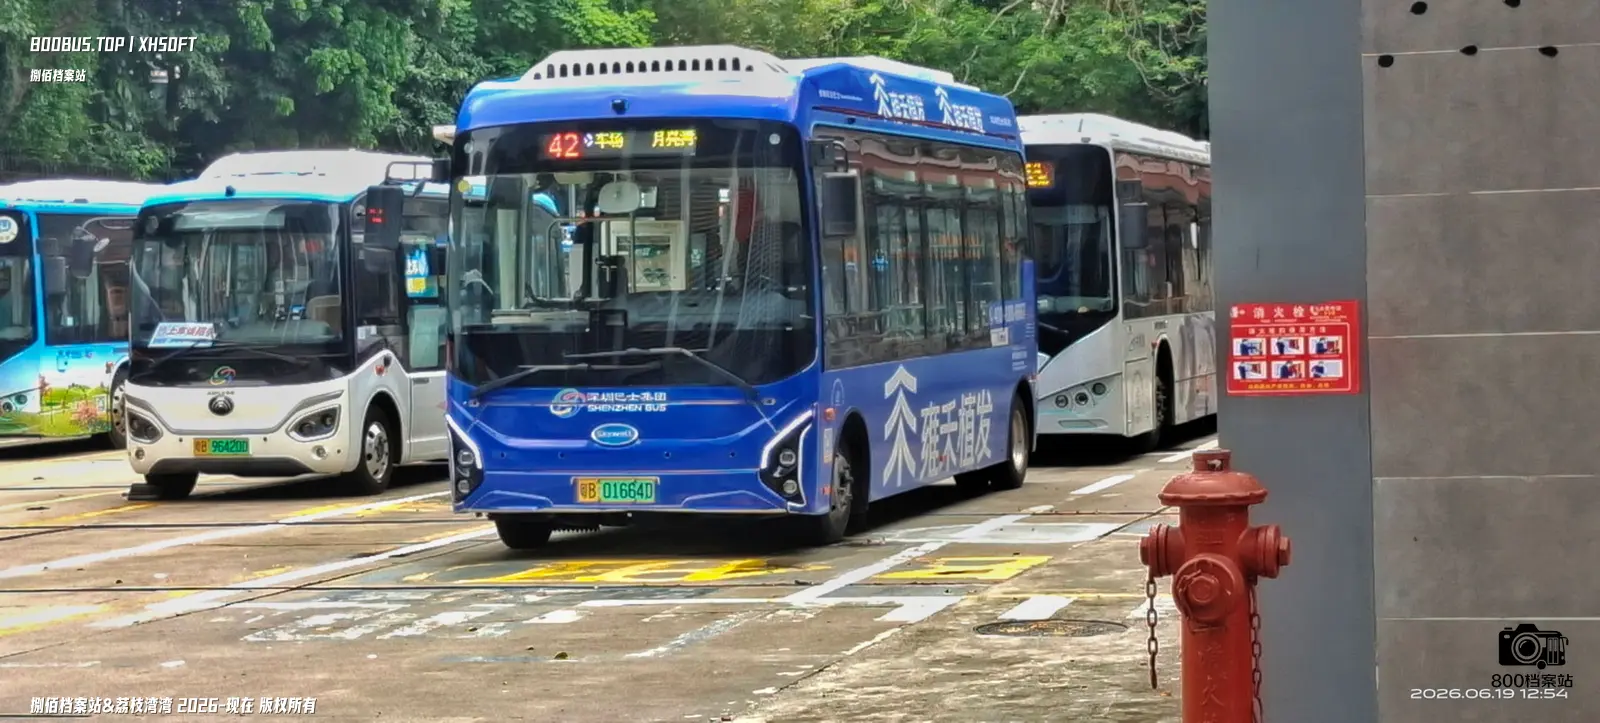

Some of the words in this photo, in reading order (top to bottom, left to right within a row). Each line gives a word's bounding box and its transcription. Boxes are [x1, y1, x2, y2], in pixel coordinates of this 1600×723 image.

[548, 132, 579, 158] 42
[594, 132, 624, 149] 车场
[1253, 305, 1305, 319] 消火栓
[586, 391, 667, 402] 深圳巴士集团
[587, 403, 642, 412] SHENZHEN
[644, 403, 667, 412] BUS
[920, 388, 993, 480] 雍禾植发
[602, 482, 653, 499] 01664D
